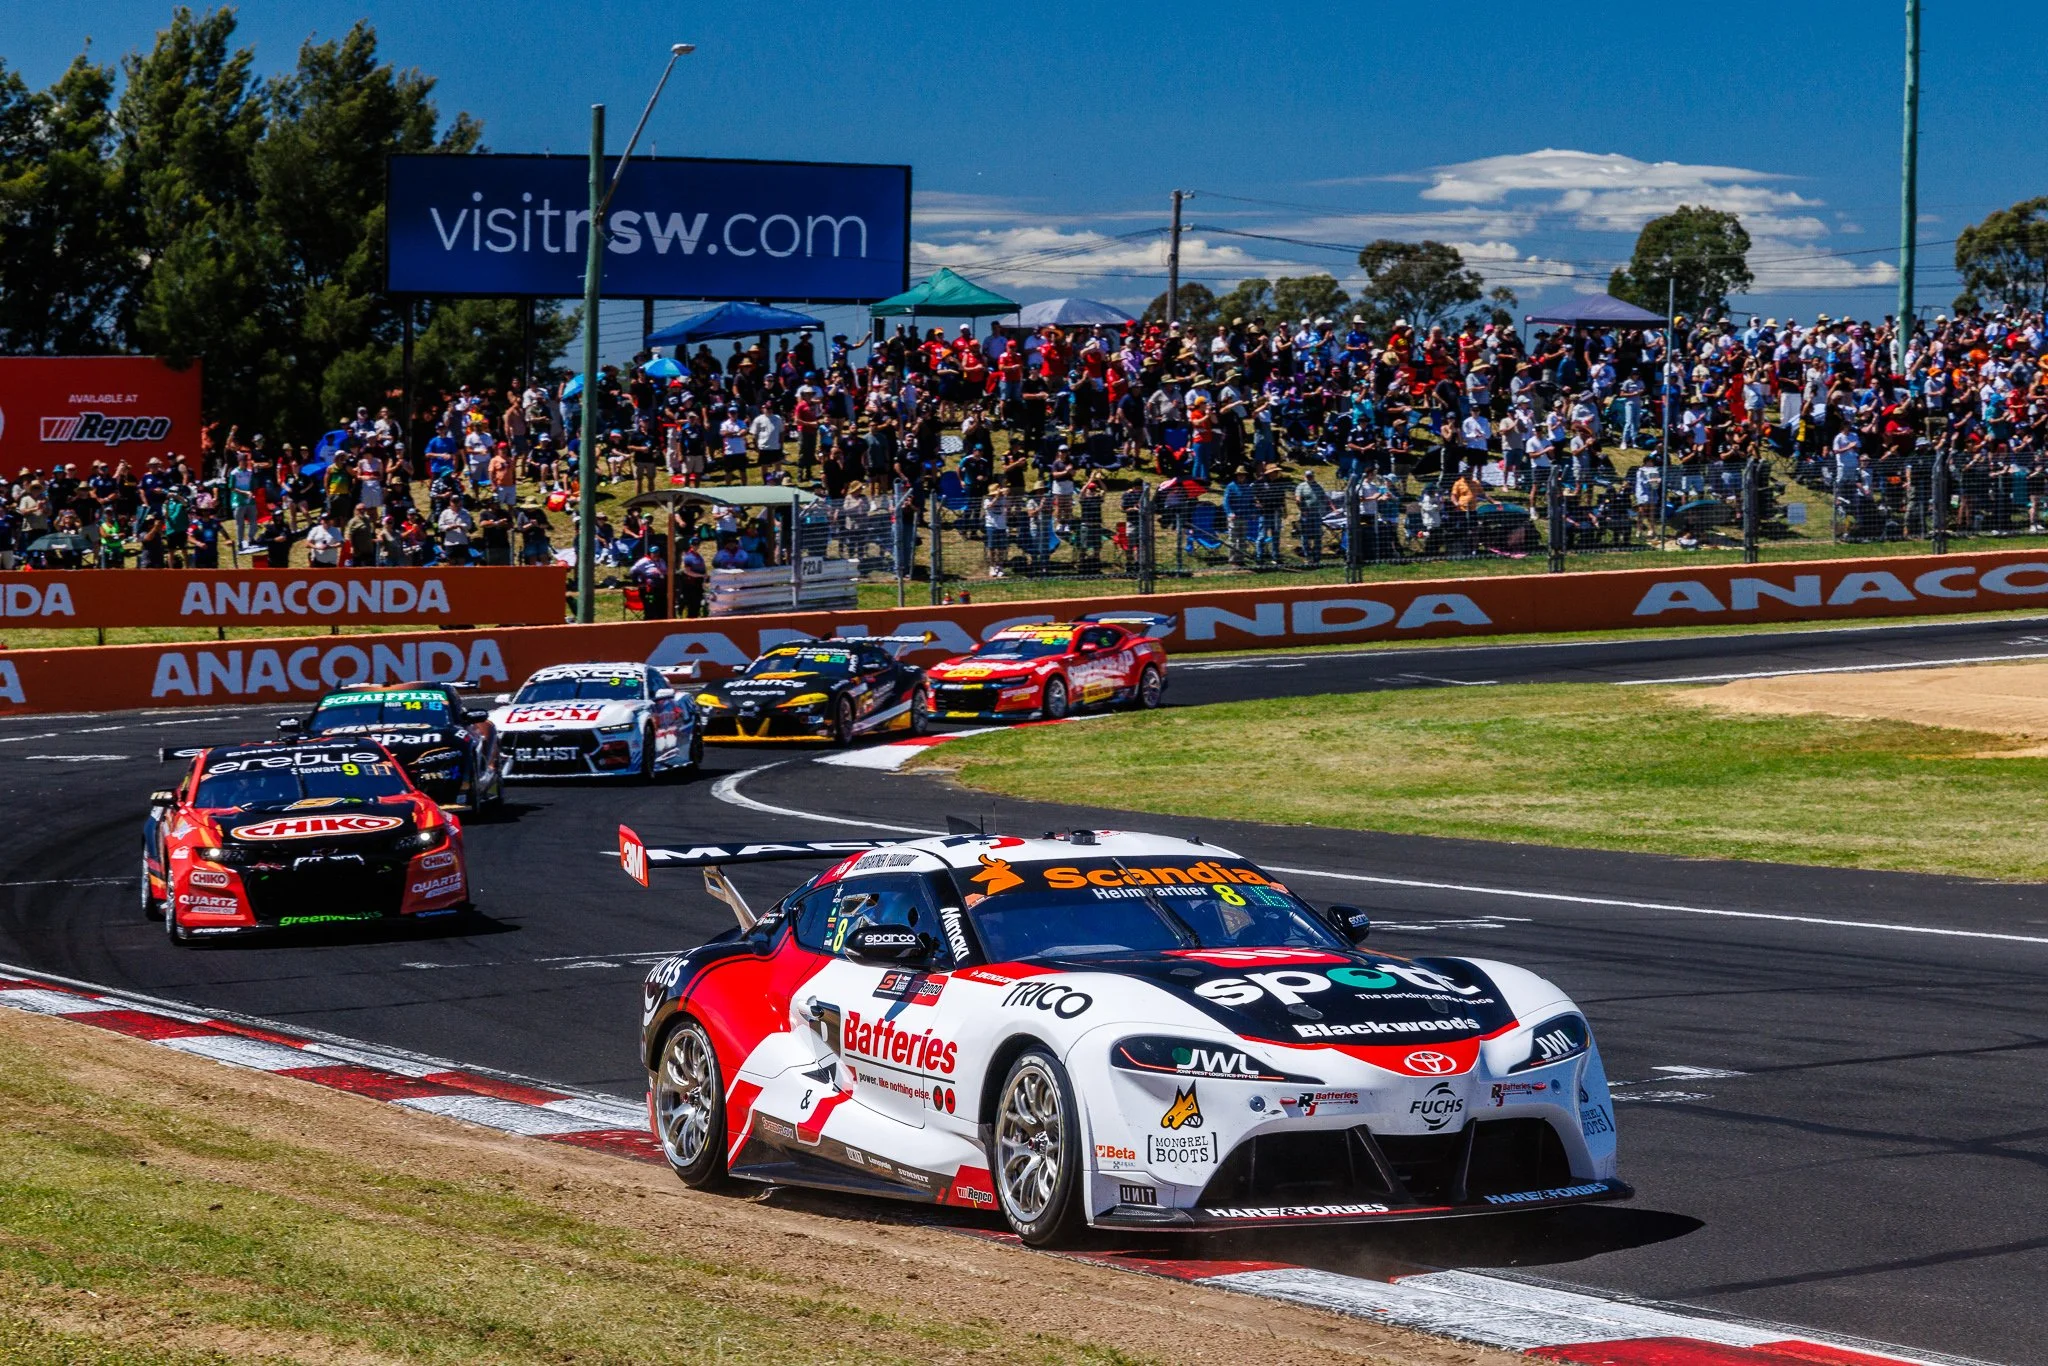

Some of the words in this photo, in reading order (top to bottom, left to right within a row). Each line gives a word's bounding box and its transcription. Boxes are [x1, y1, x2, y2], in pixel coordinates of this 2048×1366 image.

[69, 394, 123, 404] AVAILABLE
[125, 394, 138, 403] AT
[72, 412, 171, 446] Repco
[180, 579, 451, 616] ANACONDA
[1632, 563, 2048, 616] ANACO
[0, 583, 76, 617] DA
[151, 638, 509, 698] ANACONDA
[535, 669, 636, 682] DAYCO
[608, 678, 620, 686] 3
[321, 692, 446, 707] SCHAEFFLER
[403, 701, 422, 711] 14
[508, 709, 599, 723] MOLY
[208, 752, 380, 775] erebus
[290, 764, 342, 776] Stewart
[342, 763, 360, 776] 9
[244, 817, 390, 837] CHIKO
[623, 841, 644, 880] 3M
[192, 873, 226, 885] CHIKO
[412, 872, 462, 893] QUARTZ
[1042, 861, 1271, 889] Scandia
[178, 894, 239, 908] QUARTZ
[1091, 885, 1208, 900] Heimartner
[1212, 884, 1247, 907] 8
[833, 917, 848, 953] 8
[865, 933, 916, 946] sparco
[940, 907, 970, 962] Mimaki
[1001, 981, 1094, 1020] TRICO
[1388, 992, 1432, 1001] parking
[1292, 1016, 1480, 1039] Blackwoods
[844, 1010, 958, 1074] Batteries
[1534, 1029, 1579, 1059] JWL
[1176, 1048, 1260, 1075] JWL
[859, 1072, 879, 1087] power.
[878, 1077, 889, 1089] like
[889, 1081, 913, 1098] nothing
[914, 1087, 931, 1100] else.
[1315, 1091, 1358, 1100] Batteries
[1502, 1083, 1531, 1091] Batteries
[1409, 1098, 1464, 1115] FUCHS
[1155, 1136, 1209, 1148] MONGREL
[1106, 1145, 1136, 1160] Beta
[1155, 1147, 1209, 1163] BOOTS
[966, 1186, 993, 1204] Repco
